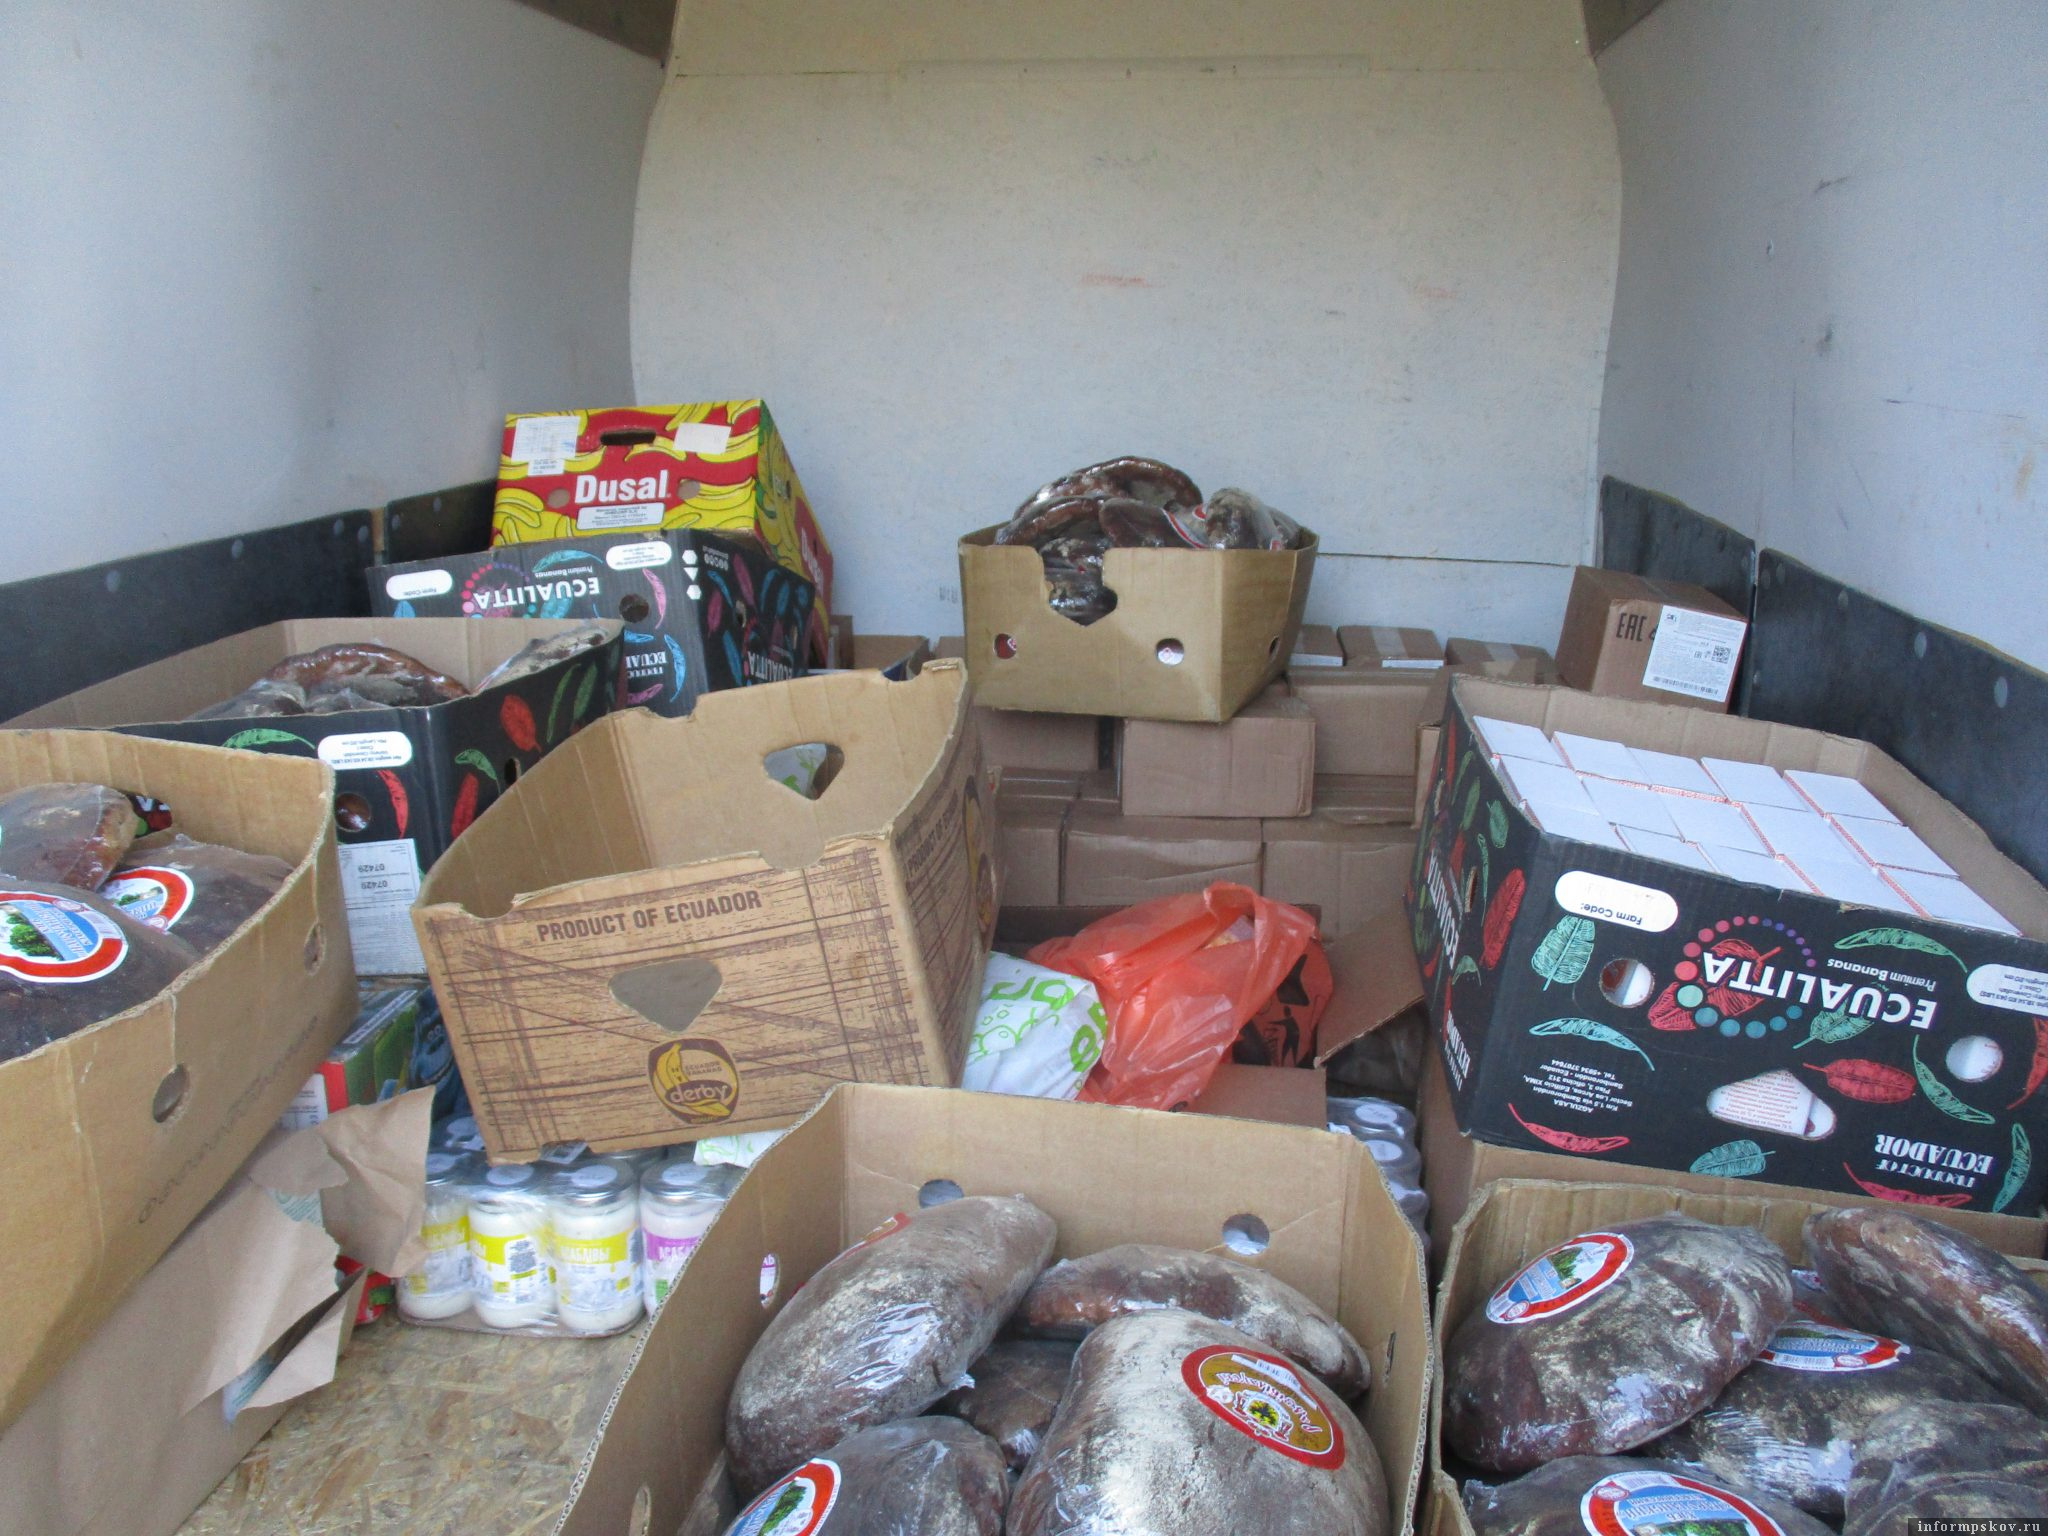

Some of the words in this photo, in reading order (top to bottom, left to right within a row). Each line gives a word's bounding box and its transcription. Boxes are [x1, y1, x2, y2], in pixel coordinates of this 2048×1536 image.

[575, 469, 668, 503] Dusal
[535, 569, 567, 579] Bananas
[568, 566, 592, 574] Premium
[473, 577, 600, 610] ECUALITTA
[1616, 613, 1647, 641] EAC
[358, 863, 385, 873] 07429
[361, 880, 388, 889] 07429
[536, 913, 626, 941] PRODUCT
[633, 908, 658, 928] OF
[664, 890, 763, 924] ECUADOR
[1581, 903, 1613, 922] Code:
[1615, 909, 1643, 926] Farm
[1827, 959, 1887, 981] Bananas
[1890, 972, 1936, 992] Premium
[1702, 953, 1937, 1029] ECUALITTA
[1540, 1065, 1569, 1075] Ecuador
[1582, 1067, 1601, 1076] +5934
[1603, 1071, 1615, 1079] Tel.
[1549, 1074, 1561, 1082] 312
[1563, 1077, 1585, 1088] oficina
[1544, 1081, 1570, 1092] Edificio
[1595, 1085, 1610, 1094] Piso
[670, 1084, 728, 1103] derby
[1572, 1087, 1594, 1098] Arcos,
[1596, 1093, 1608, 1101] Los
[1554, 1099, 1594, 1113] AGZULASA
[1606, 1103, 1618, 1111] Km
[1610, 1097, 1632, 1106] Sector
[1875, 1135, 1993, 1174] ECUADOR
[1875, 1159, 1898, 1172] OF
[1897, 1163, 1975, 1188] PRODUCT
